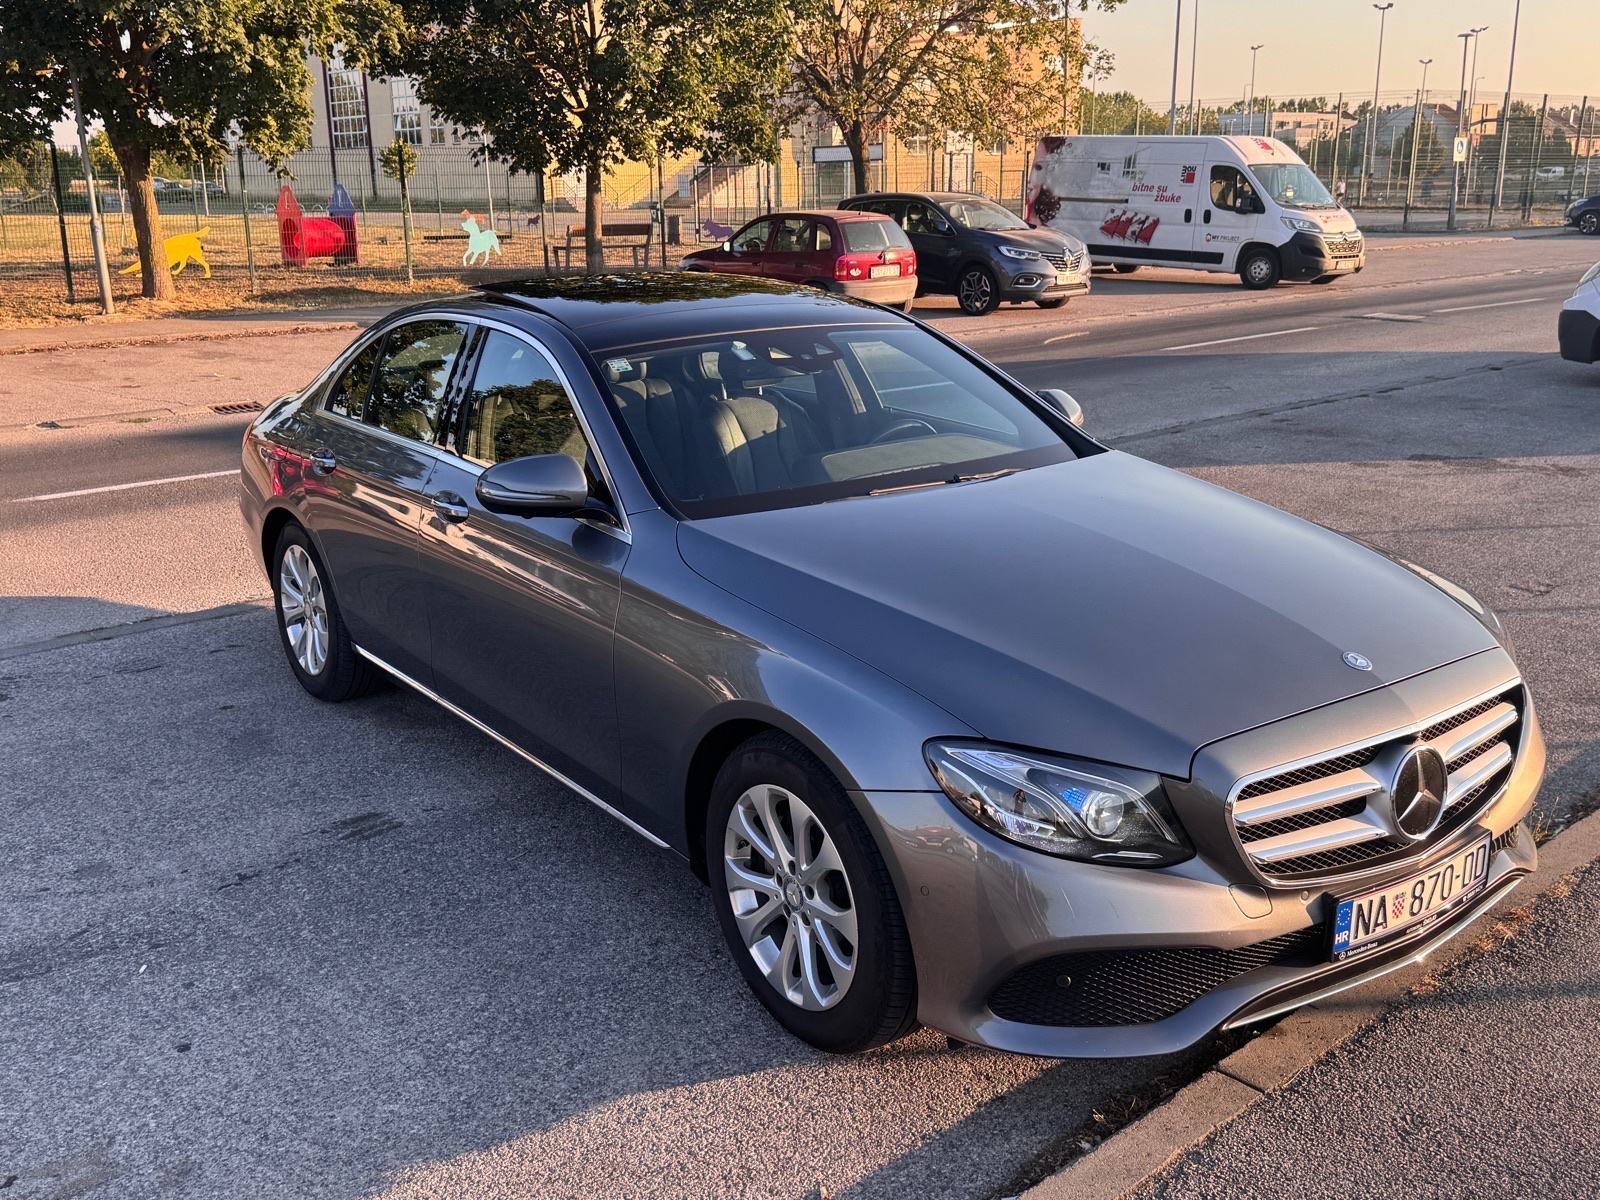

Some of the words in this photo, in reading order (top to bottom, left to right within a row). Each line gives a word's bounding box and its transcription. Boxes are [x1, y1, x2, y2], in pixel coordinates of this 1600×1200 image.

[1132, 182, 1155, 193] bitne
[1156, 184, 1168, 193] su
[1154, 192, 1182, 203] žbuke
[1352, 895, 1388, 940] NA
[1335, 930, 1349, 945] HR
